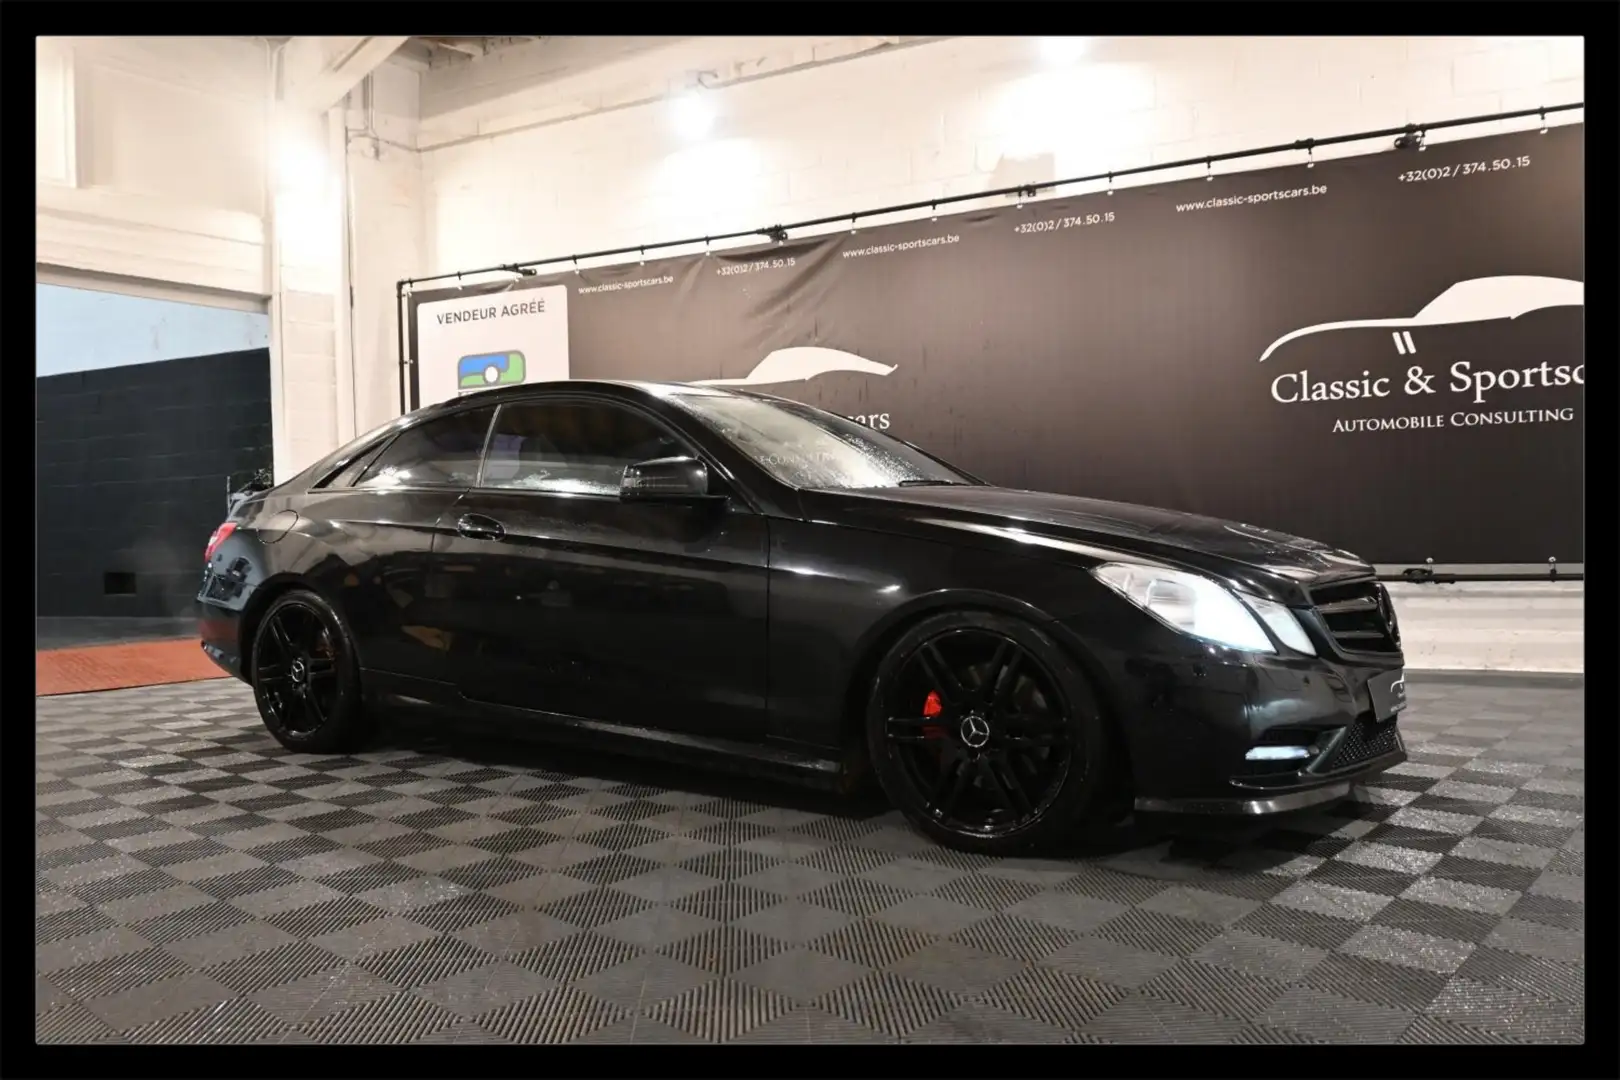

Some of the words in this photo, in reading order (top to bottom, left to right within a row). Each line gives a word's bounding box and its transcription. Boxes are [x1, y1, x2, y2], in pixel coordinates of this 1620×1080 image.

[1176, 184, 1328, 213] www.classic-sportscars.be
[842, 234, 960, 259] www.classic-sportscars.be
[577, 275, 674, 294] www.classic-sportscars.be
[436, 306, 497, 325] VENDEUR
[500, 299, 545, 318] AGRÉÉ
[1270, 370, 1391, 404] Classic
[1403, 365, 1437, 396] &
[1332, 414, 1445, 433] AUTOMOBILE
[1450, 407, 1574, 427] CONSULTING
